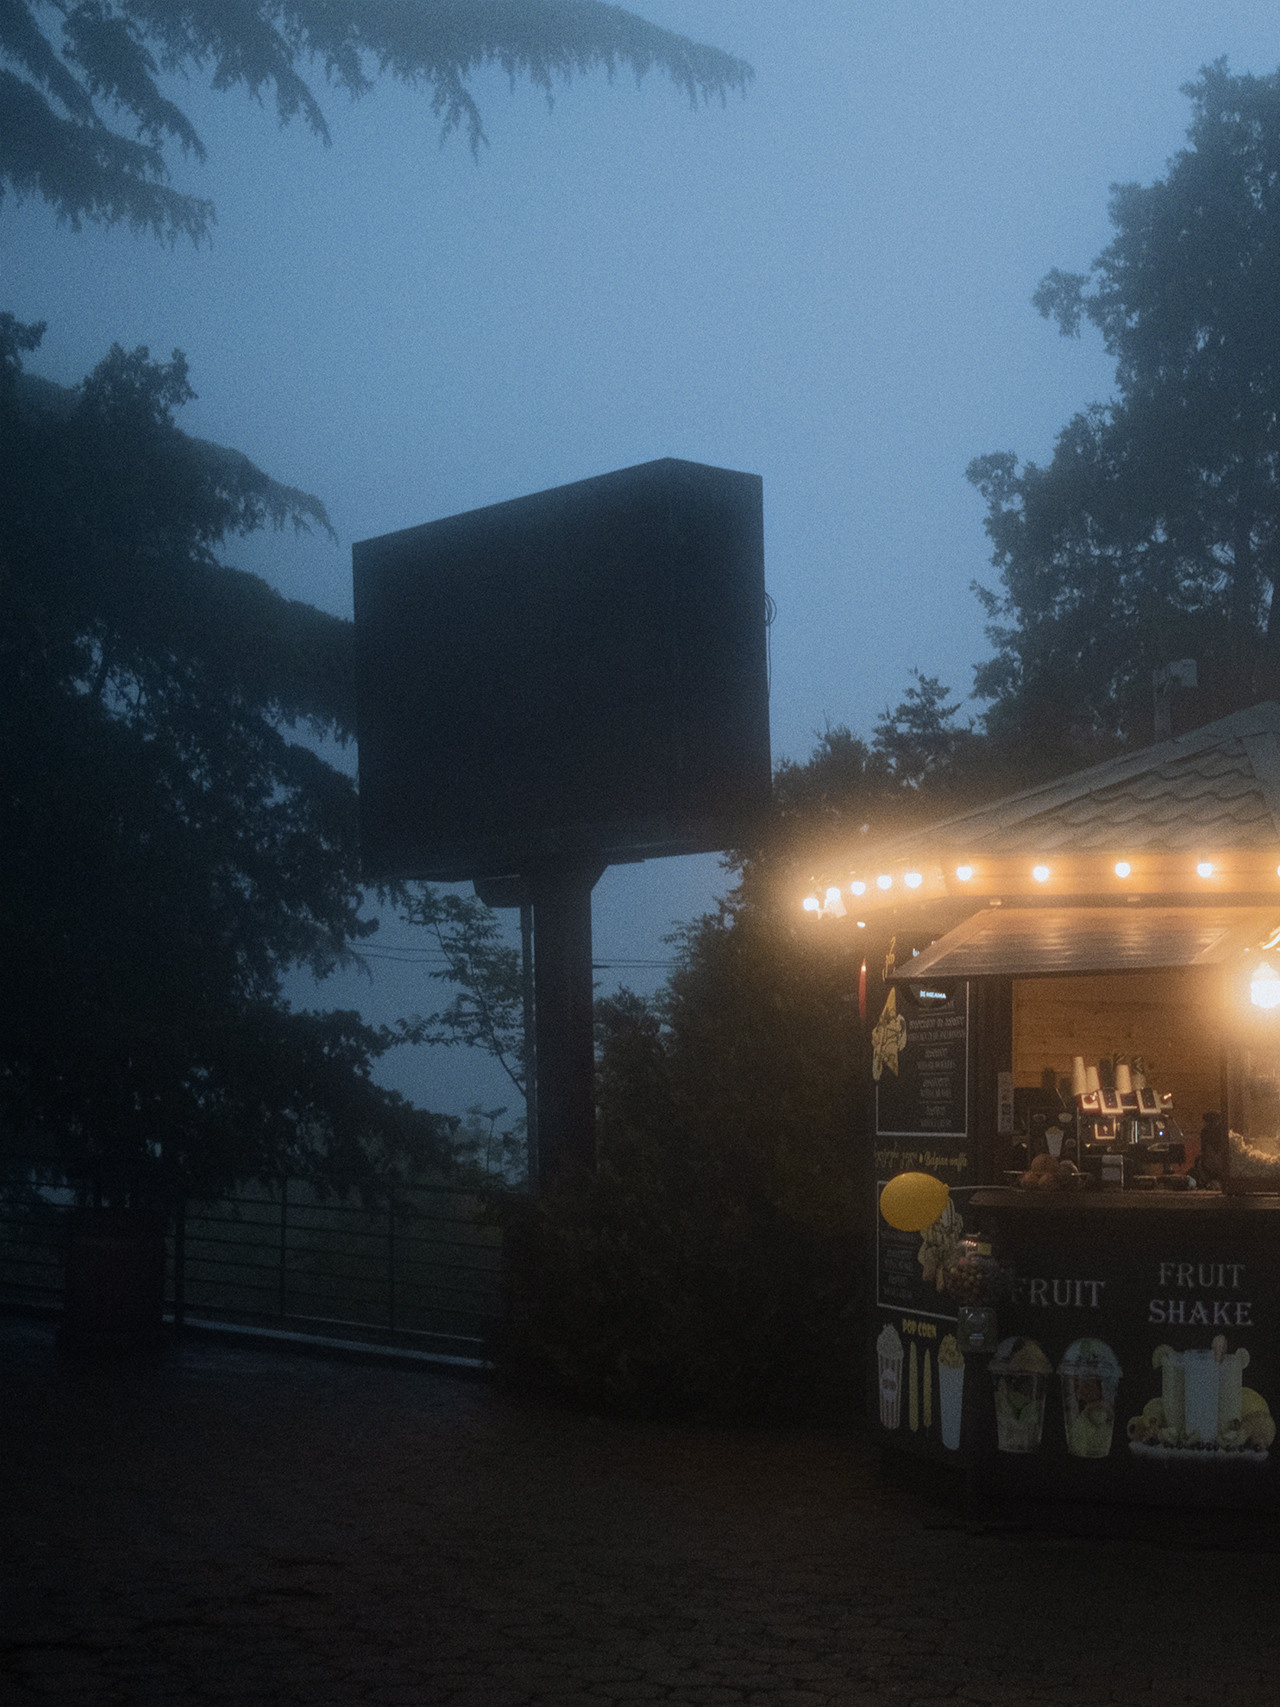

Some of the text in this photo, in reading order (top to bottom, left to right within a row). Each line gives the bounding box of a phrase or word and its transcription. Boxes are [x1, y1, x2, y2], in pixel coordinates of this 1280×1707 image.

[1158, 1262, 1247, 1289] FRUIT
[1010, 1279, 1106, 1308] FRUIT
[1147, 1299, 1254, 1326] SHAKE
